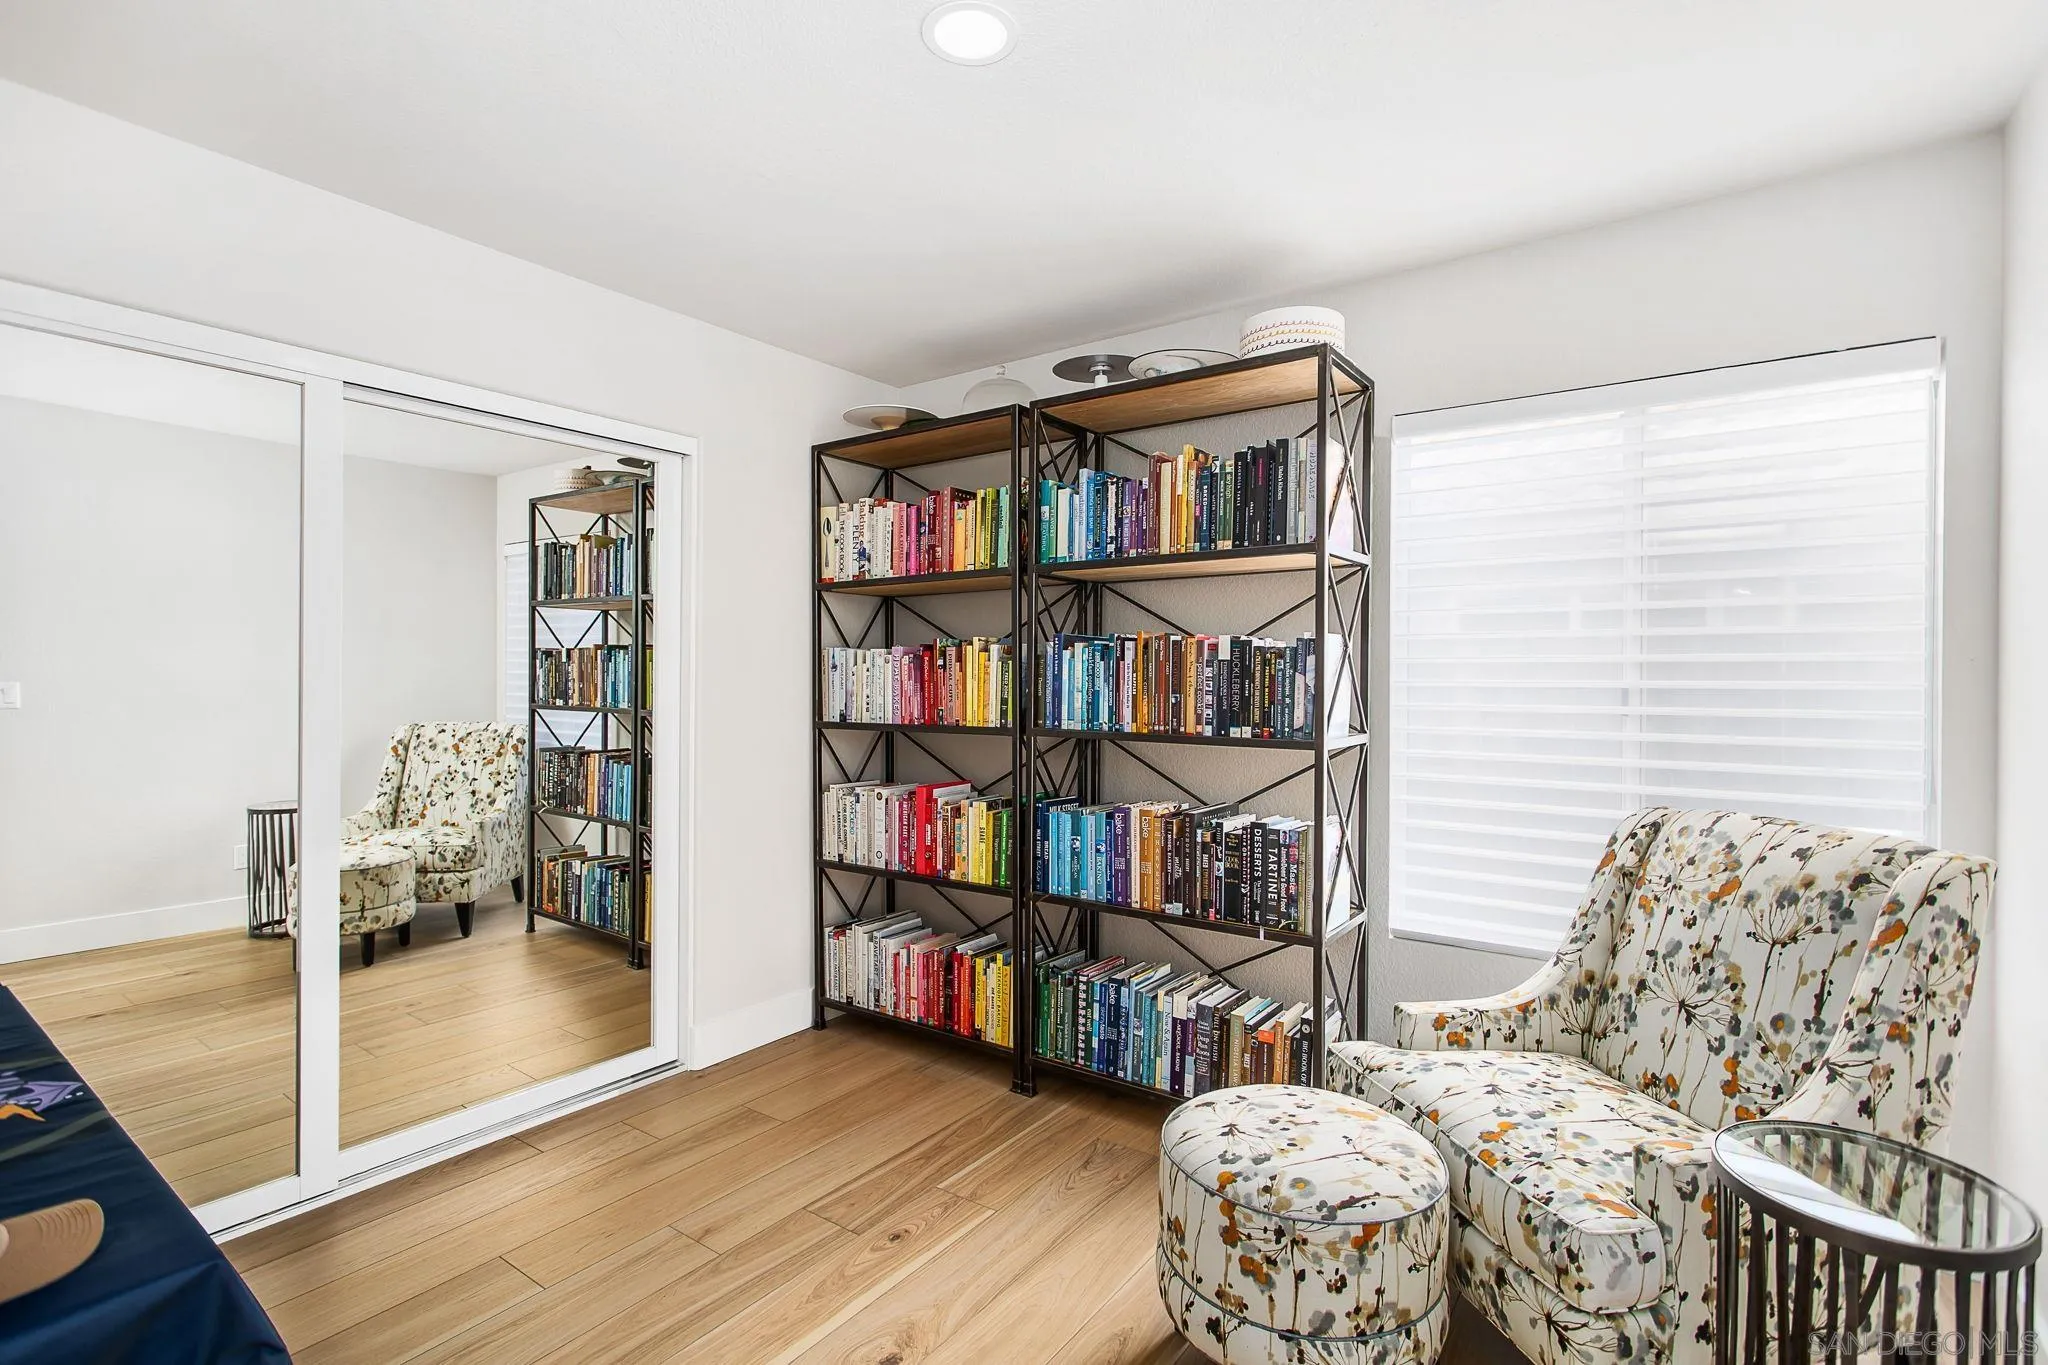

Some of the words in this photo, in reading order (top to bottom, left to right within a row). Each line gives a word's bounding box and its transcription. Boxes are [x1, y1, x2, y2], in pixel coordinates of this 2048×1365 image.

[1232, 648, 1240, 711] HUCKLEBERRY
[1115, 813, 1125, 834] bake
[1142, 816, 1151, 838] bake
[1254, 829, 1262, 877] DESSERTS
[1268, 848, 1278, 899] TARTINE
[1289, 864, 1297, 895] Master
[1109, 983, 1118, 1004] bake
[1301, 1073, 1307, 1083] OF
